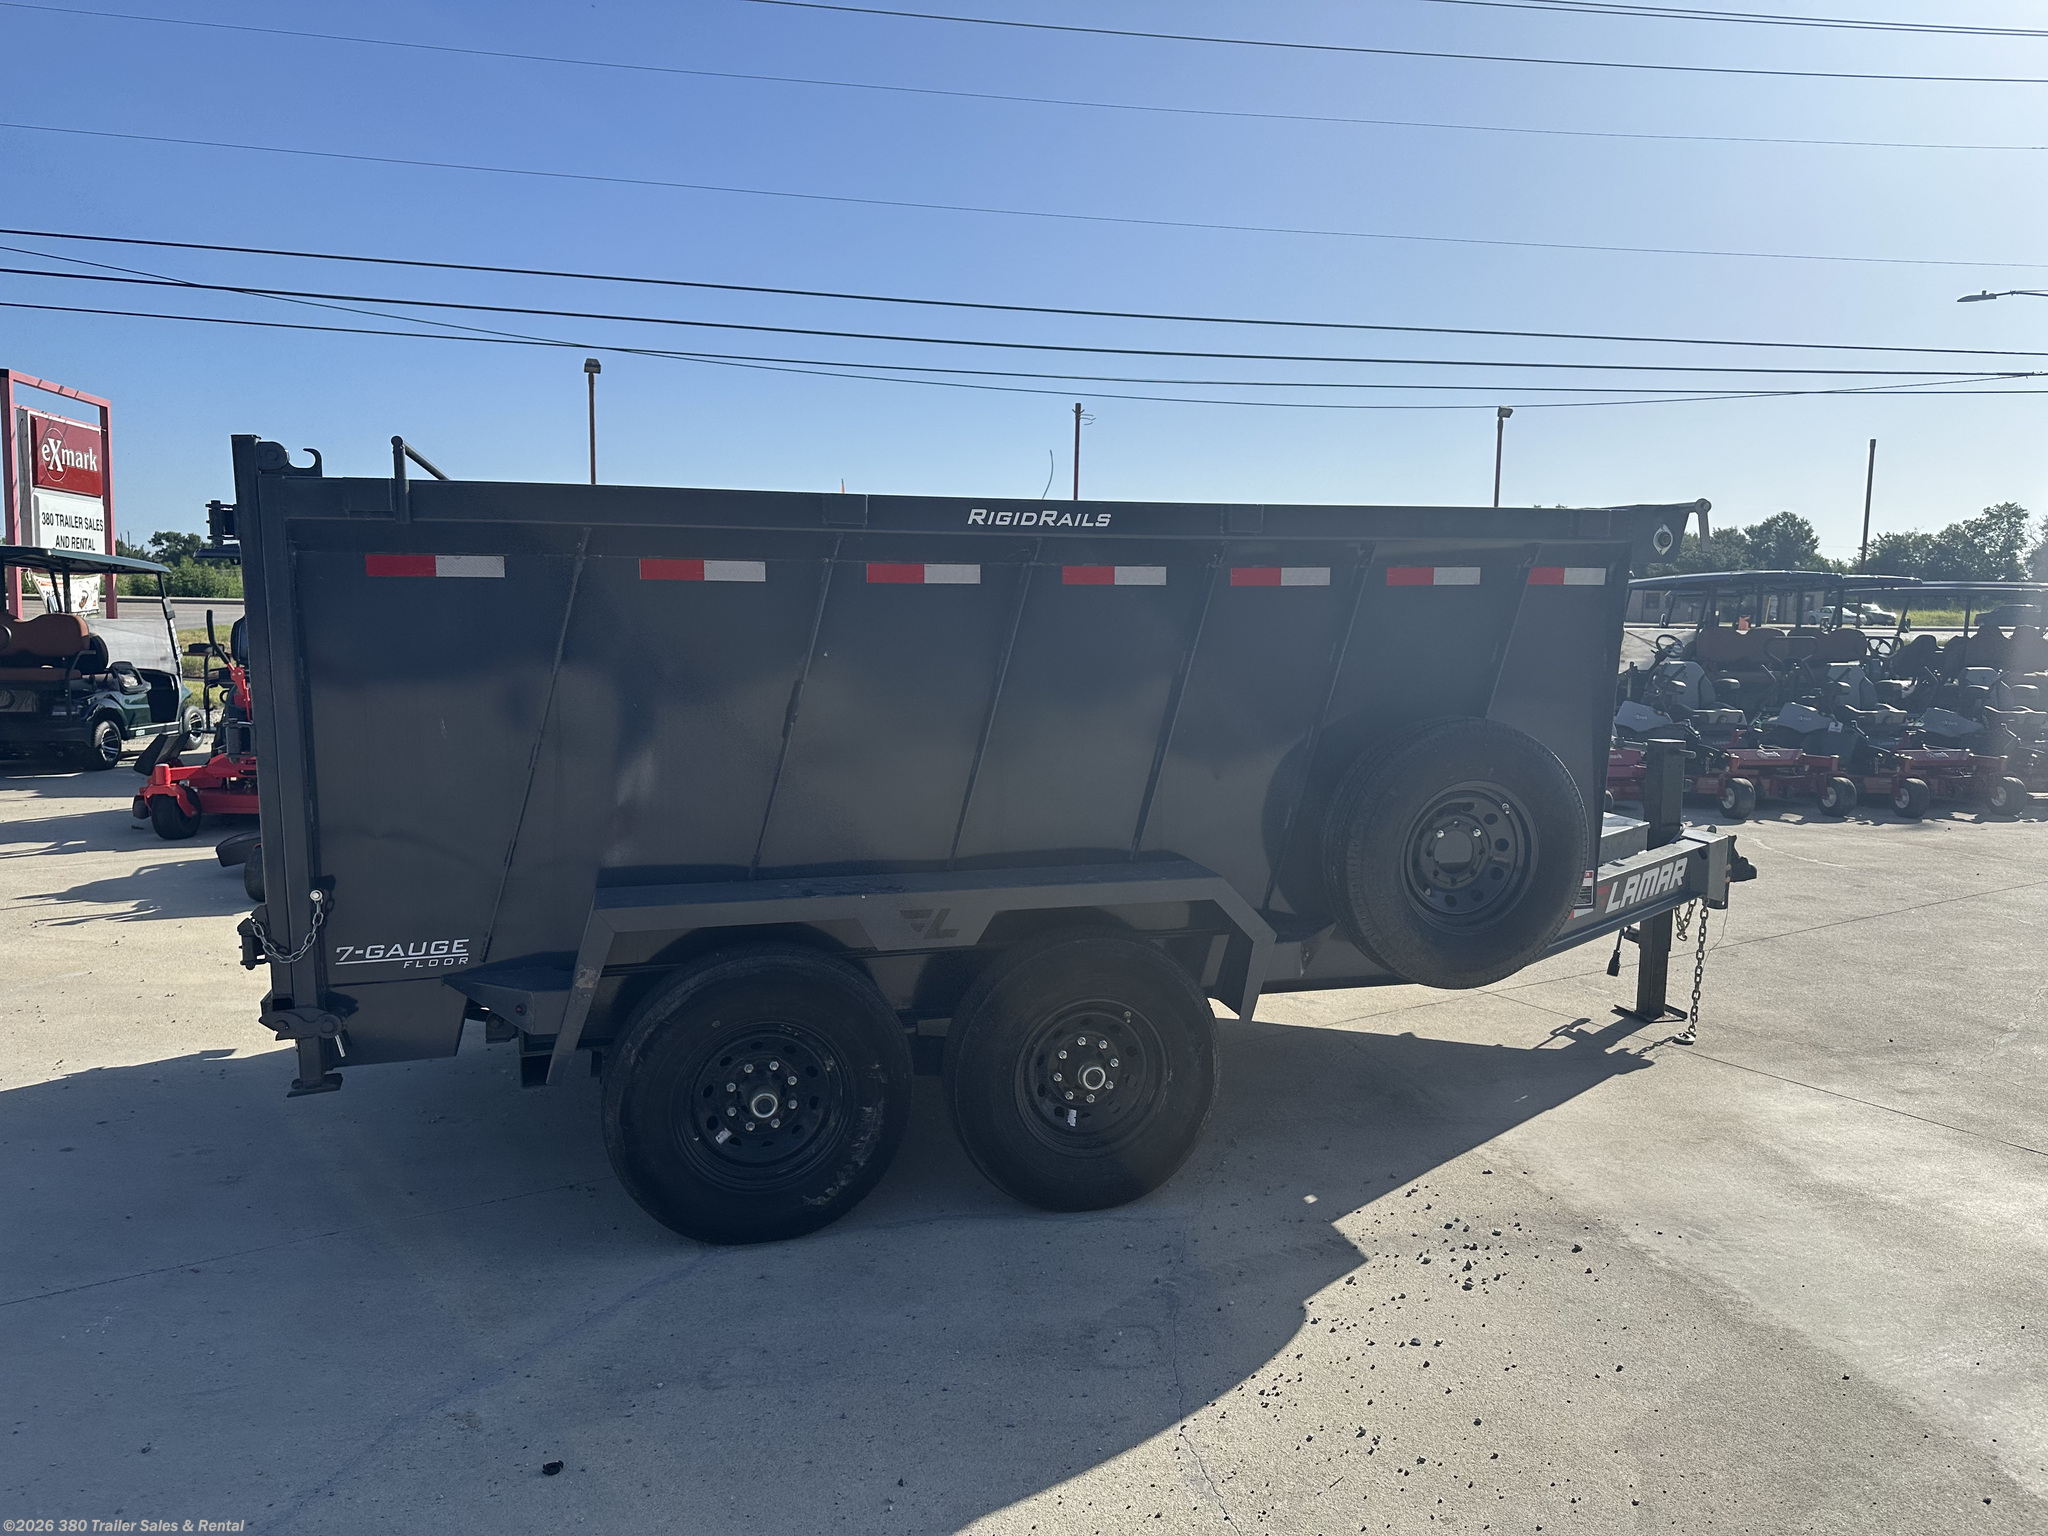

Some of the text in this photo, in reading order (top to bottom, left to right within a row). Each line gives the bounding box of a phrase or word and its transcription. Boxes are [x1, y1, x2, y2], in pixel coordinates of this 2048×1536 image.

[41, 438, 98, 472] eXmark
[41, 512, 104, 532] 380 TRAILER SALES
[55, 535, 96, 551] AND RENTAL
[1605, 857, 1688, 914] LAMAR
[336, 939, 470, 962] 7-GAUGE
[403, 957, 469, 968] FLOOR
